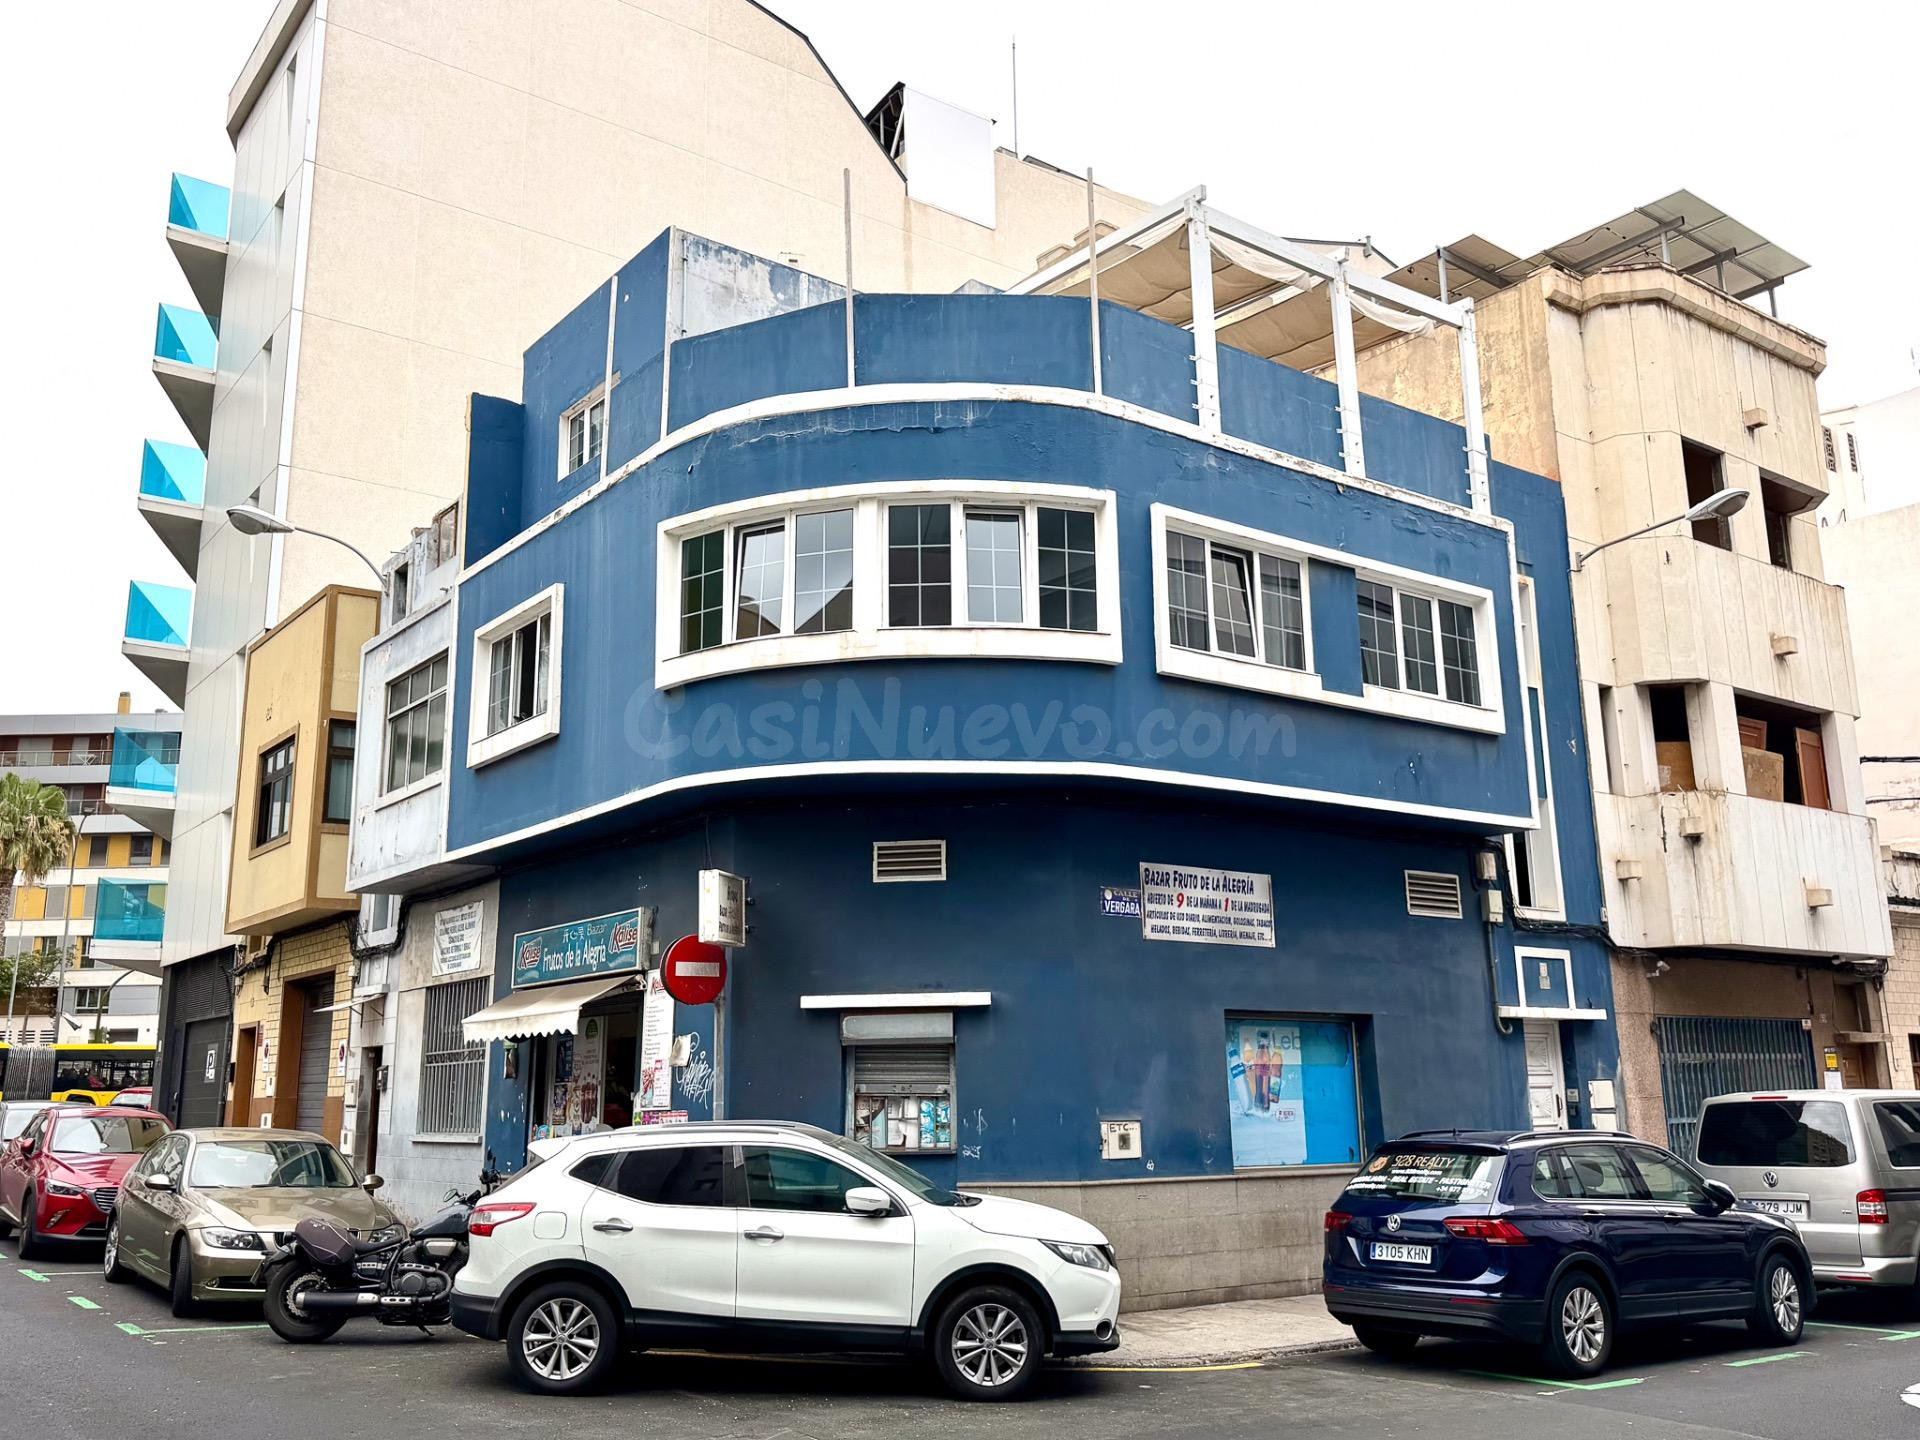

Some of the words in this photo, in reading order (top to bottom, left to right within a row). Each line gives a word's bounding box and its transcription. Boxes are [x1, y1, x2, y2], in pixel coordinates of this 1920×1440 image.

[1143, 867, 1170, 888] BAZAR
[1173, 870, 1198, 890] FRUTO
[1200, 875, 1210, 891] DE
[1211, 876, 1220, 892] LA
[1222, 875, 1254, 896] ALEGRÍA
[1113, 890, 1138, 898] CALLE
[1147, 892, 1166, 905] ABIERTO
[1167, 893, 1174, 906] DE
[1176, 892, 1185, 908] 9
[1186, 895, 1193, 907] DE
[1193, 896, 1199, 908] LA
[1224, 897, 1230, 912] 1
[1230, 899, 1238, 912] DE
[1104, 899, 1140, 916] VERGARA
[1169, 911, 1176, 921] DE
[587, 923, 608, 936] Bazar
[612, 922, 638, 952] Kalise
[520, 943, 541, 967] Kalise
[543, 947, 564, 972] Frutos
[565, 942, 575, 968] de
[582, 938, 606, 971] Alegría
[1391, 1154, 1417, 1167] 928
[1412, 1154, 1456, 1169] REALTY
[1783, 1203, 1803, 1214] JJM
[1377, 1245, 1404, 1259] 3105
[1406, 1246, 1429, 1261] KHN
